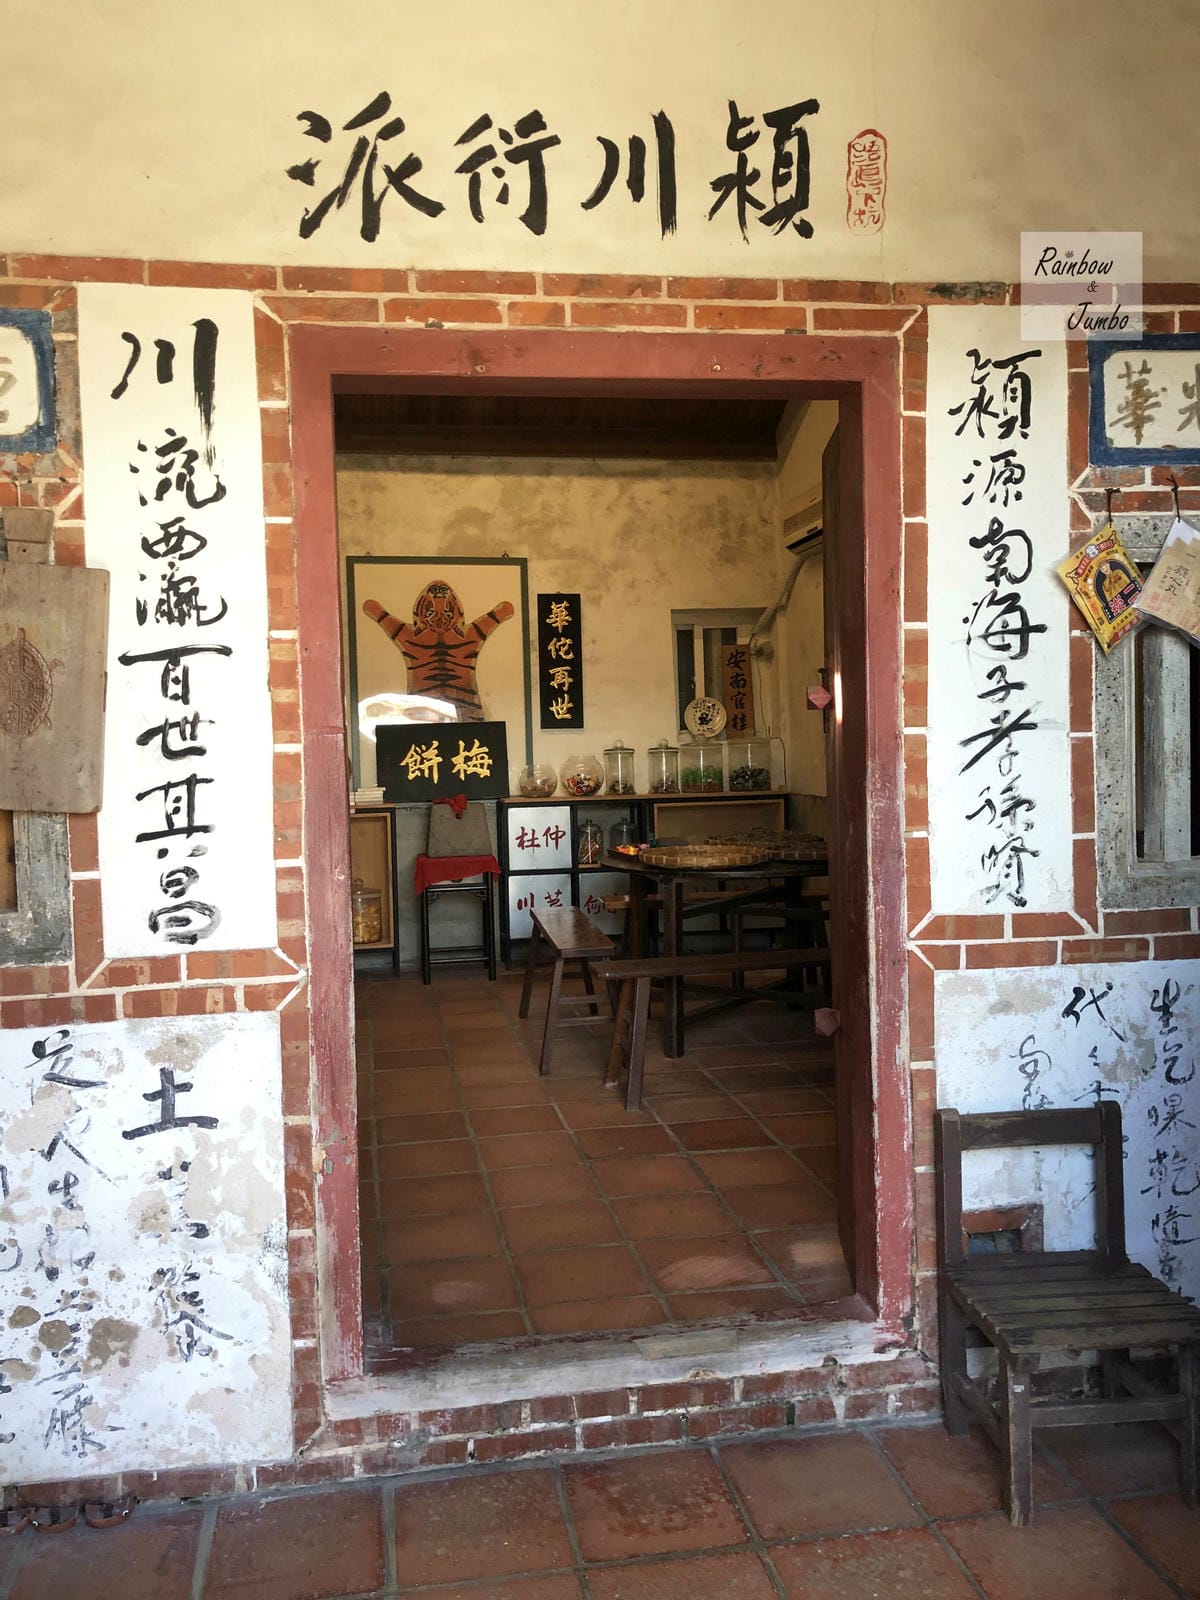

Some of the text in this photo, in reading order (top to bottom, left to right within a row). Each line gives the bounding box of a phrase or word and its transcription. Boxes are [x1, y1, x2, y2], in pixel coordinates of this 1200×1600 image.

[545, 600, 575, 721] 華佗再世
[515, 825, 567, 851] 杜仲
